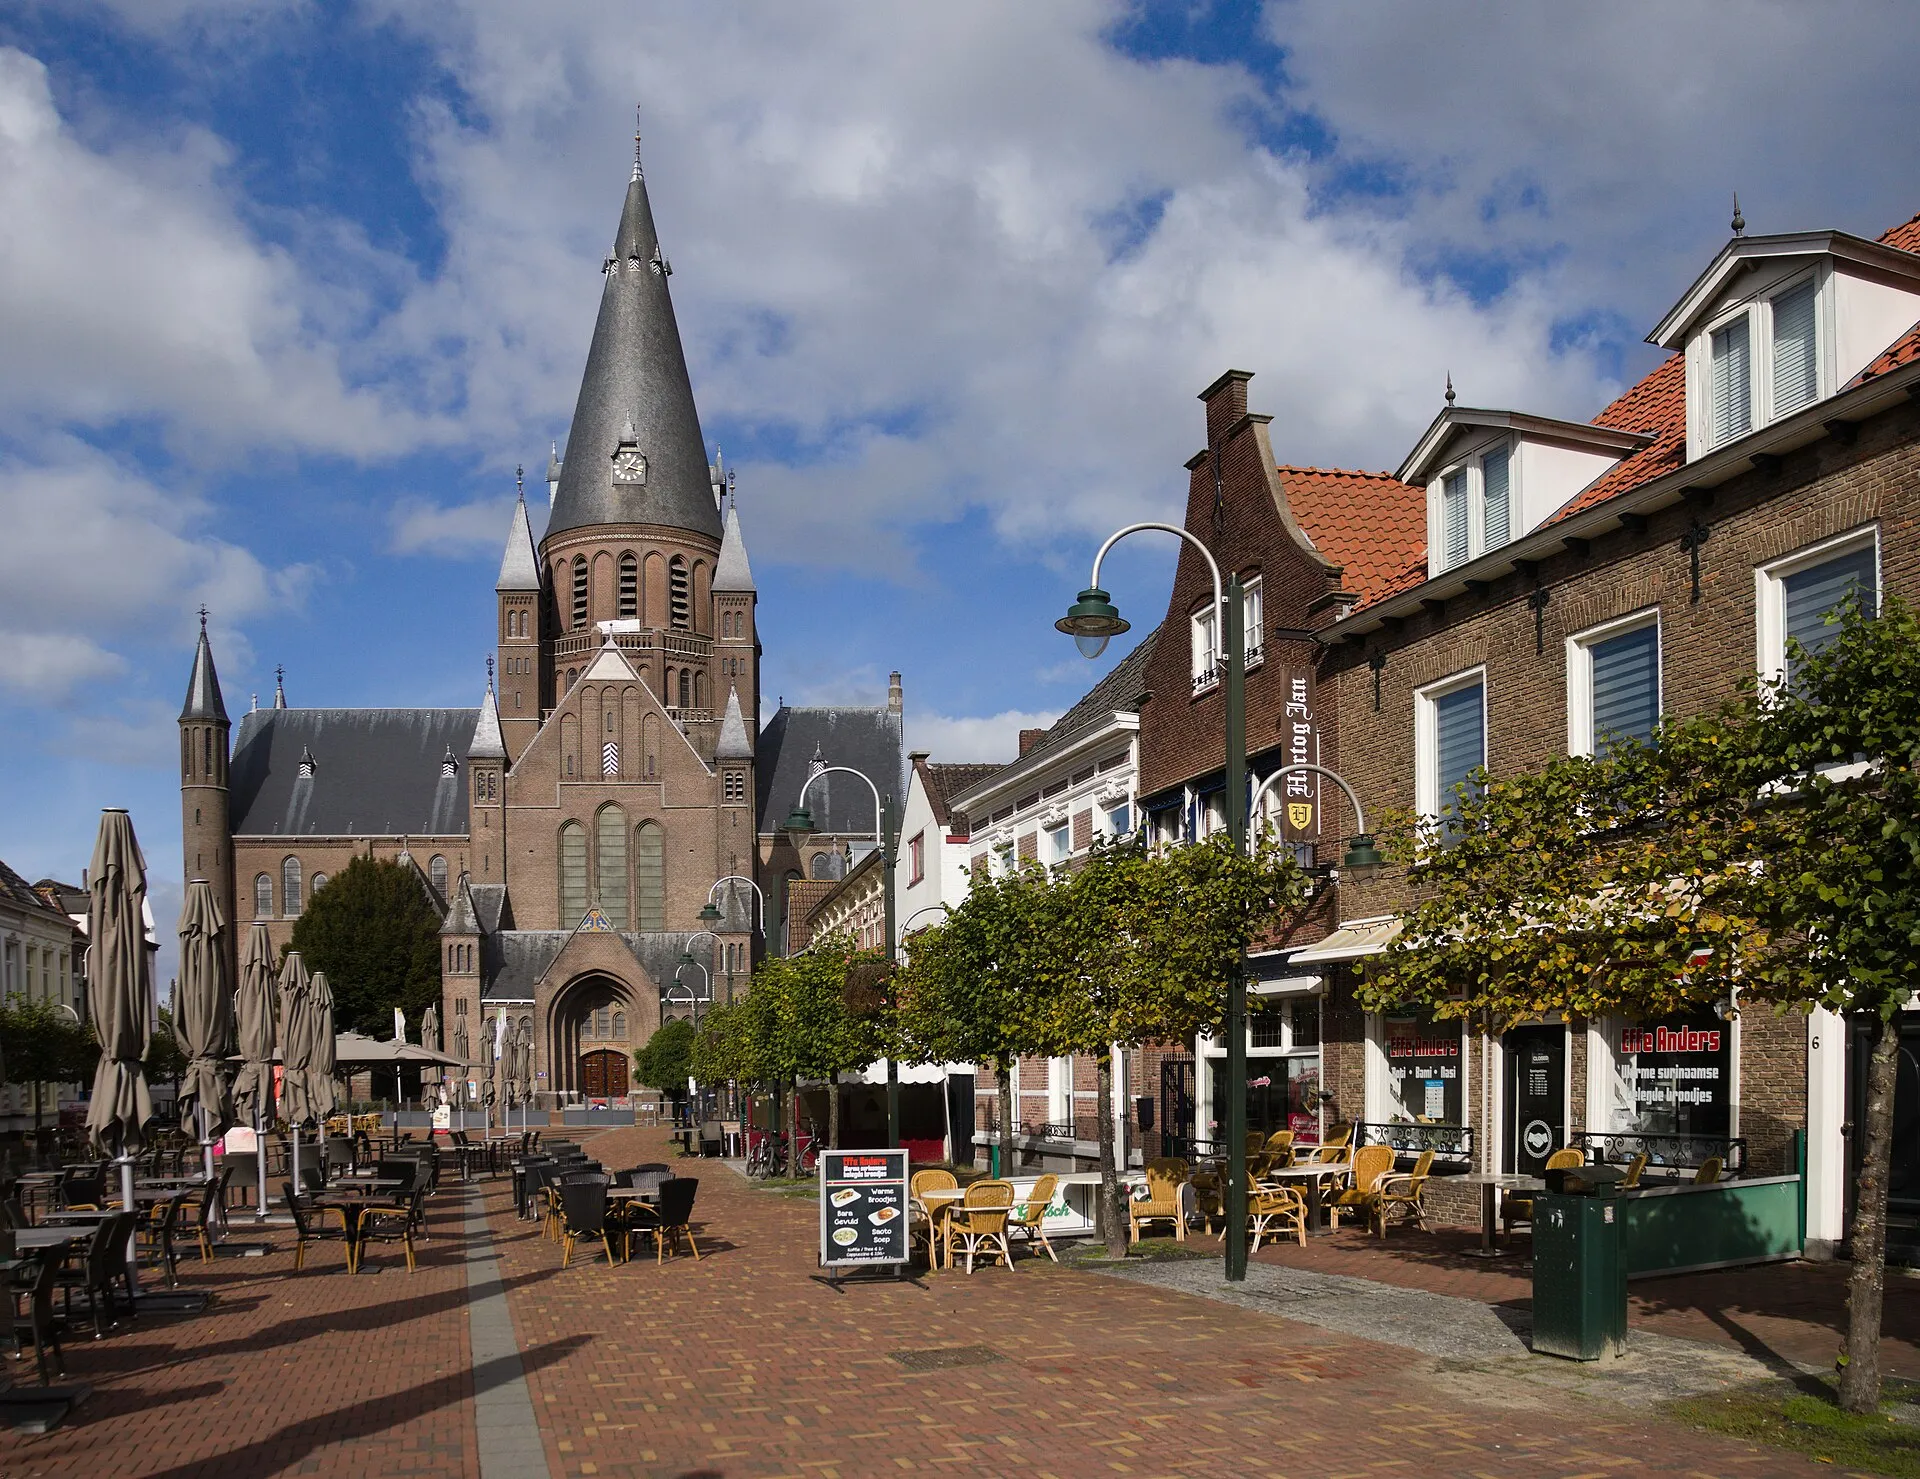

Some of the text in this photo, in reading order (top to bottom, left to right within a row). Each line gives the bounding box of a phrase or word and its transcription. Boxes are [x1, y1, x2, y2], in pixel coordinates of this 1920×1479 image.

[1286, 677, 1313, 720] Jan
[1390, 1034, 1459, 1057] Effe Anders
[1621, 1025, 1720, 1053] Effe Anders
[1811, 1036, 1820, 1050] 6
[1415, 1066, 1433, 1079] Bami
[1440, 1066, 1457, 1079] Nasi
[1621, 1064, 1719, 1079] Warme surinaamse
[1666, 1087, 1713, 1106] broodjes
[868, 1196, 897, 1204] Broodjes
[873, 1236, 891, 1244] Soep
